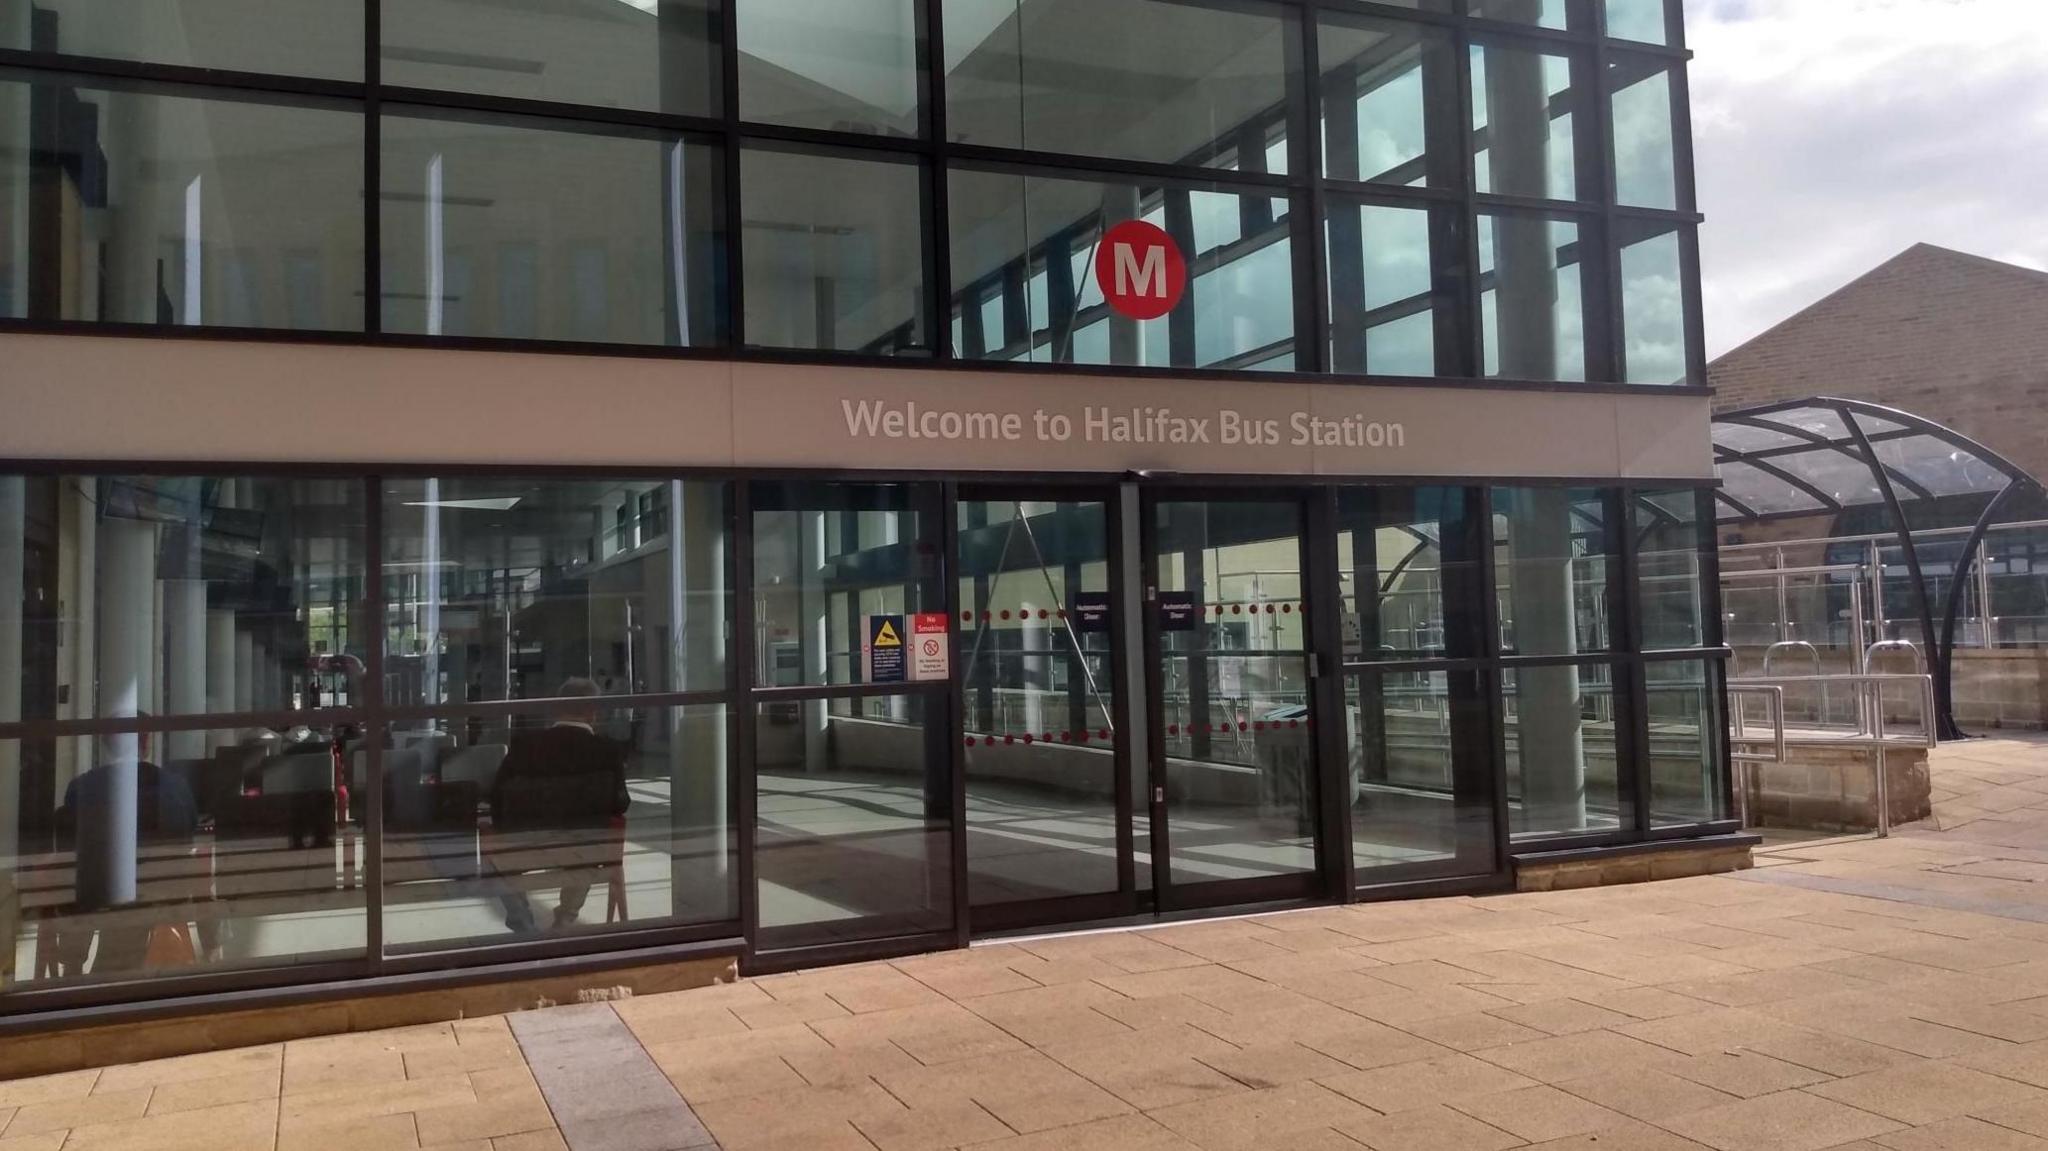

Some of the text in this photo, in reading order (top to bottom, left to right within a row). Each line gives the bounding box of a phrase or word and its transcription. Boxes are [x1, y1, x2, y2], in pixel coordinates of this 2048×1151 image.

[1113, 242, 1167, 298] M
[841, 399, 1405, 447] Welcome to Halifax Bus Station
